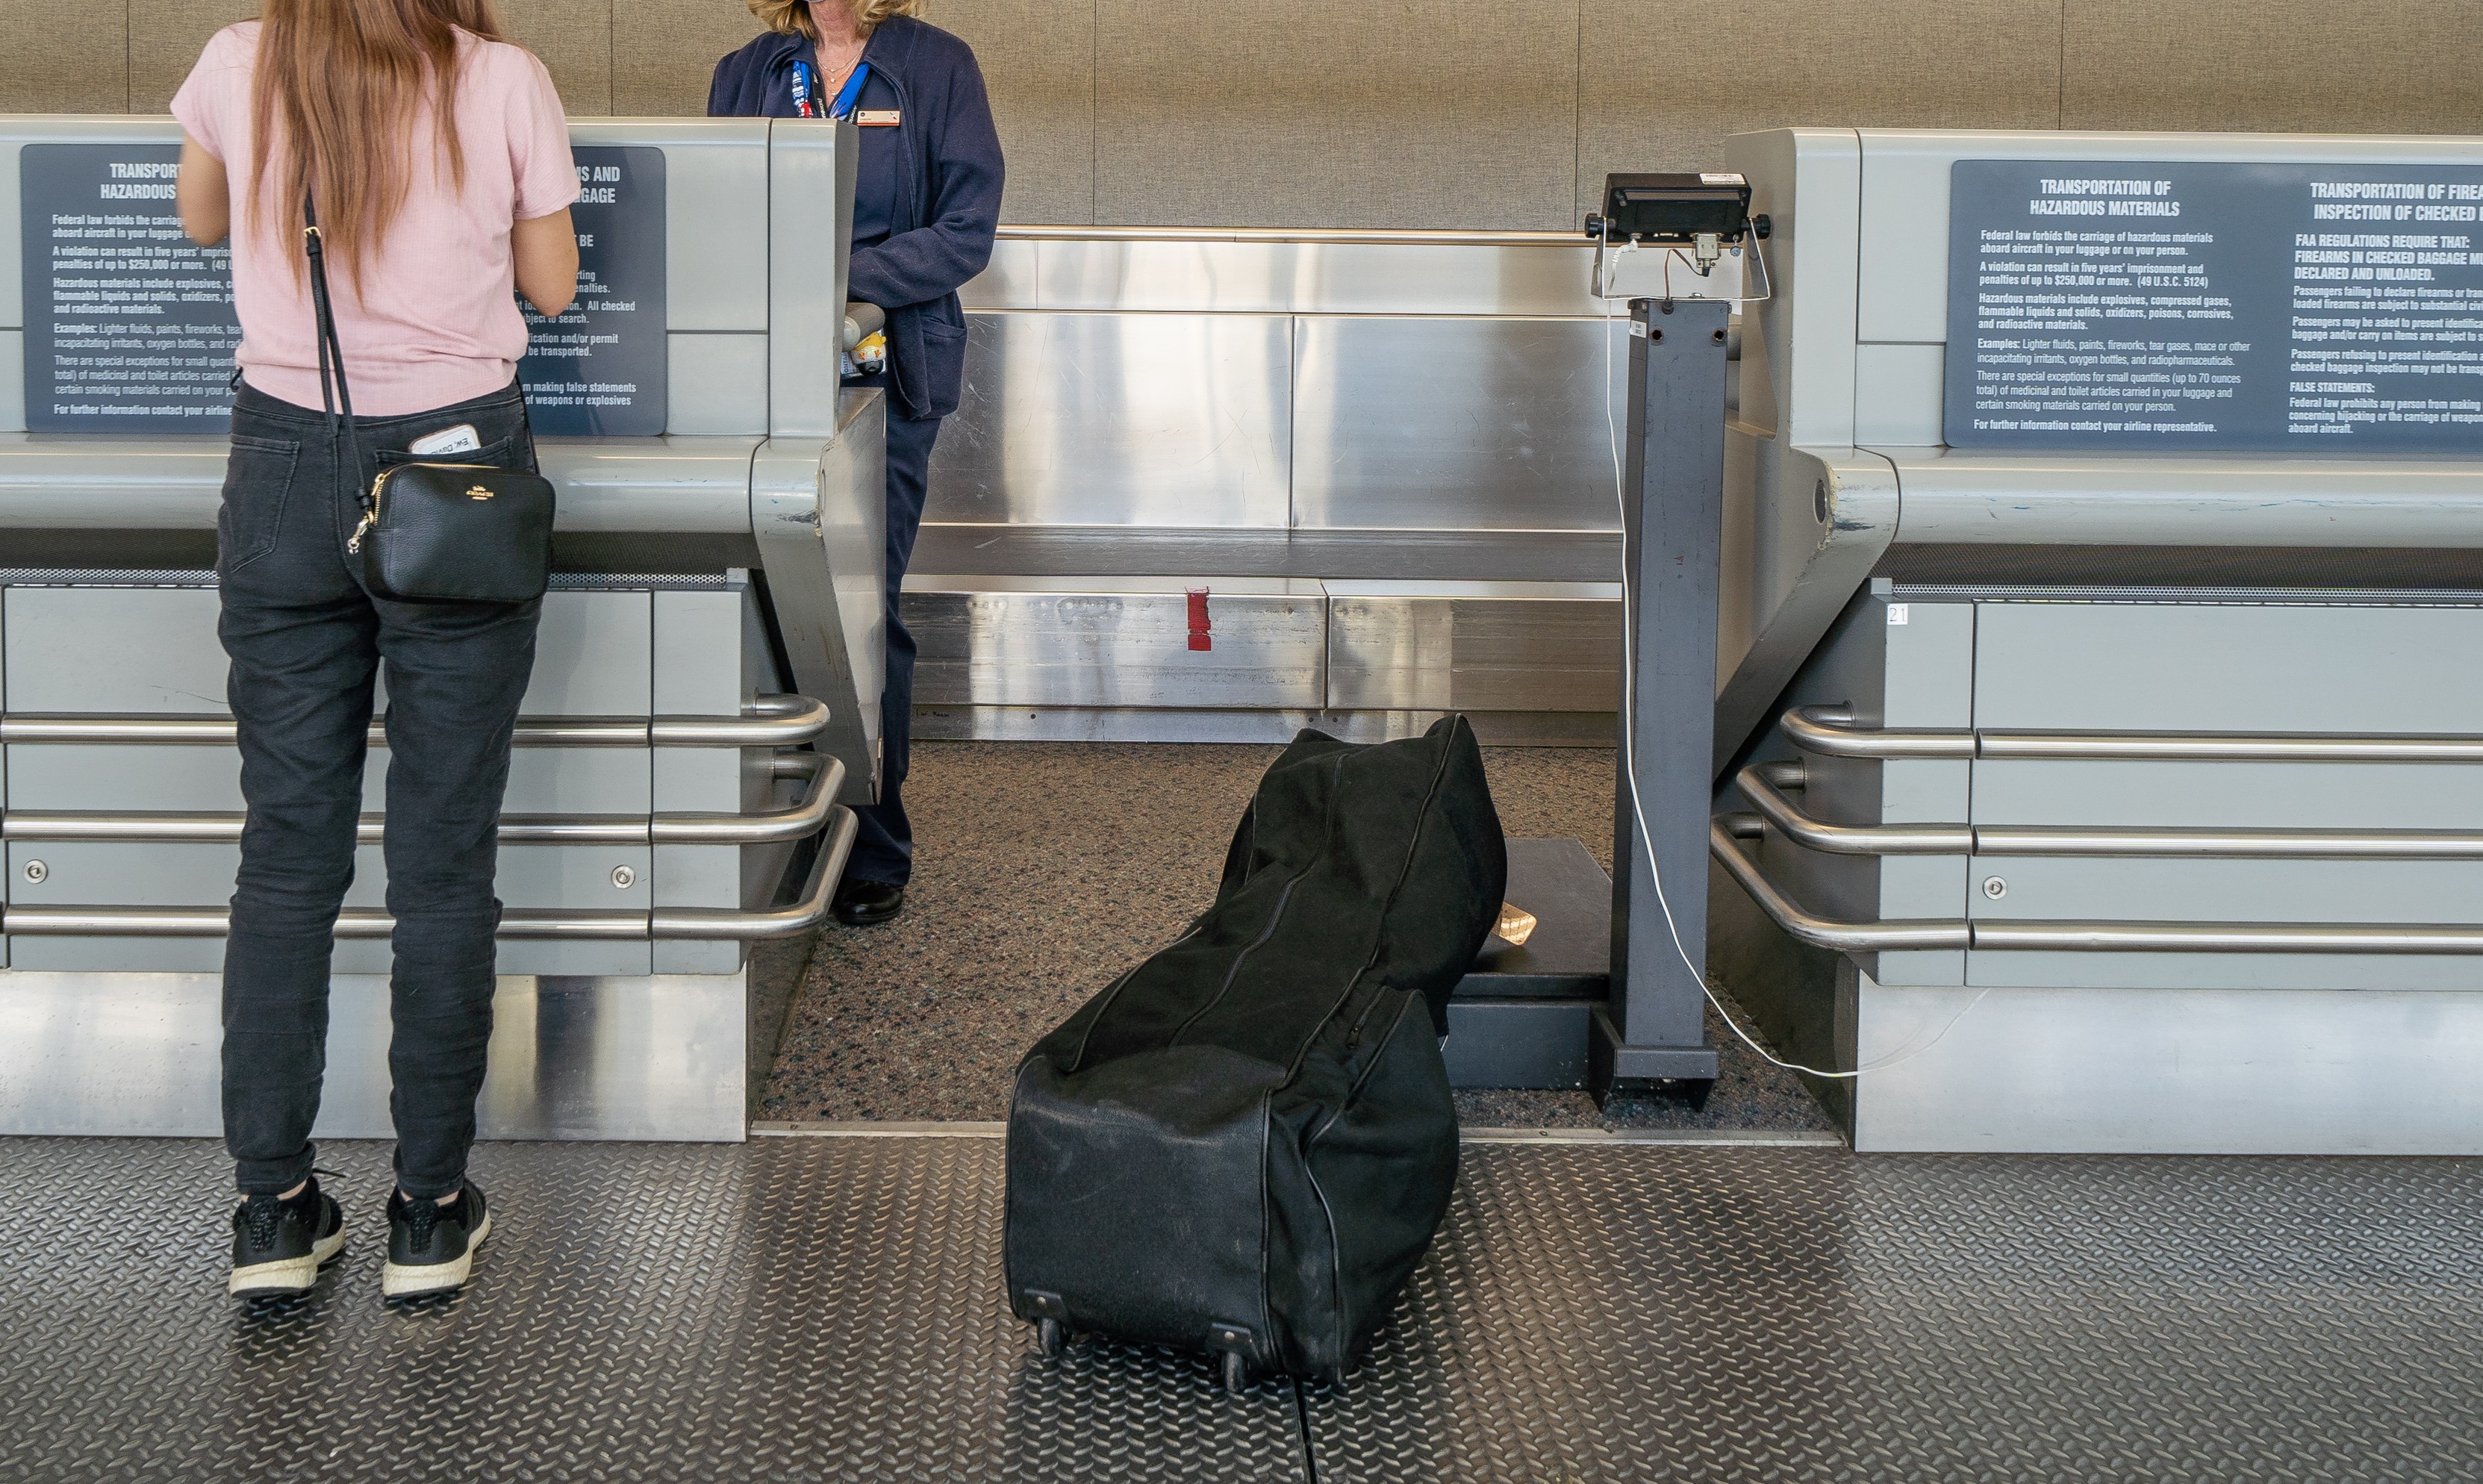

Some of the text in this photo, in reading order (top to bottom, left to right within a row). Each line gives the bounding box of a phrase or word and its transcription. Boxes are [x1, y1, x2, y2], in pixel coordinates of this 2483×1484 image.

[594, 166, 620, 182] AND
[2040, 179, 2171, 196] TRANSPORTATION OF
[2310, 183, 2424, 200] TRANSPORTATION
[2427, 184, 2445, 200] OF
[574, 187, 616, 204] GAGE
[2030, 200, 2180, 216] HAZARDOUS MATERIALS
[2314, 205, 2391, 221] INSPECTION
[2394, 205, 2412, 221] OF
[2415, 205, 2476, 222] CHECKED
[579, 234, 594, 247] BE
[1981, 231, 2213, 244] Federal law forbids the carriage of hazardous materials
[2296, 234, 2470, 249] FAA REGULATIONS REQUIRE THAT:
[1980, 243, 2188, 258] aboard aircraft in your luggage or on your person.
[2295, 251, 2349, 264] FIREARMS
[2352, 252, 2364, 264] IN
[2366, 252, 2414, 264] CHECKED
[2417, 252, 2467, 265] BAGGAGE
[1979, 262, 1987, 272] A
[1987, 262, 2025, 272] violation
[2027, 264, 2043, 272] can
[2044, 263, 2069, 273] result
[2070, 263, 2079, 273] in
[2081, 263, 2097, 273] five
[2127, 264, 2186, 276] imprisonment
[2187, 264, 2203, 274] and
[2294, 267, 2435, 281] DECLARED AND UNLOADED.
[575, 283, 611, 293] enalties.
[1979, 275, 2208, 290] penalties of up to $250,000 or more. (49 U.S.C. 5124)
[588, 301, 599, 311] All
[601, 301, 636, 311] checked
[1978, 293, 2231, 308] Hazardous materials include explosives, compressed gases,
[559, 314, 590, 324] search.
[1978, 307, 2234, 320] flammable liquids and solids, oxidizers, poisons, corrosives,
[1978, 319, 2088, 331] and radioactive materials.
[561, 333, 588, 344] and/or
[591, 334, 619, 346] permit
[1978, 340, 2251, 353] Examples: Lighter fluids, paints, fireworks, tear gases, mace or other
[529, 346, 593, 358] be transported.
[533, 381, 564, 394] making
[567, 381, 588, 392] false
[589, 382, 637, 393] statements
[2290, 382, 2375, 393] FALSE STATEMENTS:
[535, 396, 573, 407] weapons
[575, 396, 585, 405] or
[586, 395, 632, 407] explosives
[1975, 400, 2175, 414] certain smoking materials carried on your person.
[1974, 420, 2216, 434] For further information contact your airline representative.
[2288, 423, 2353, 434] aboard aircraft.
[1889, 607, 1906, 622] 21
